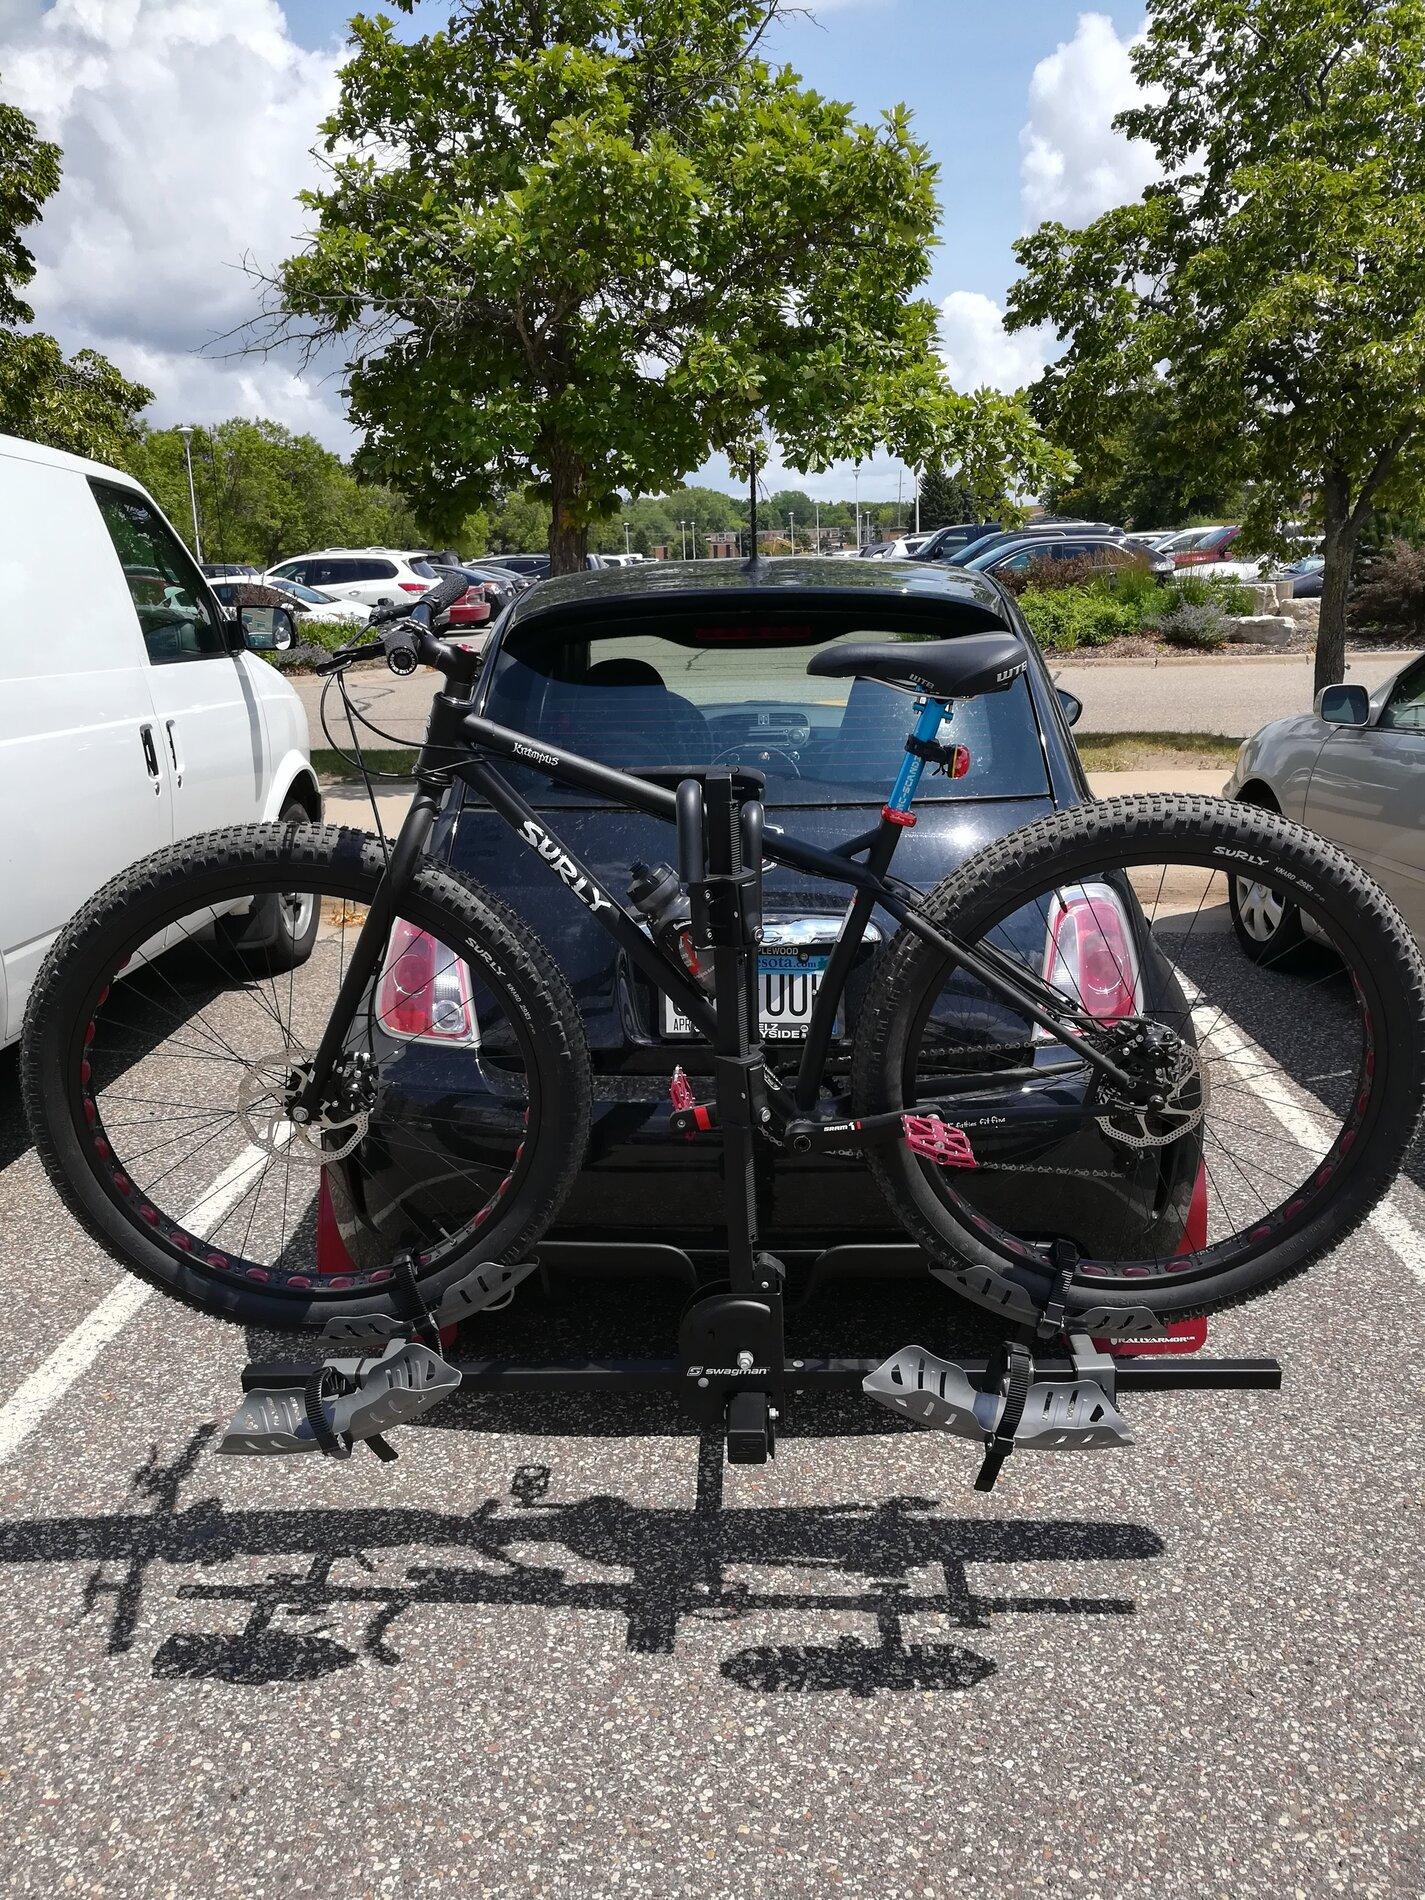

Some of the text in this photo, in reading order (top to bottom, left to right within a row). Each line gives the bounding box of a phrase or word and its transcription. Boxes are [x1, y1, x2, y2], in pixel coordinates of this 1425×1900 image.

[909, 673, 935, 689] WTB
[997, 660, 1027, 682] WTB
[516, 820, 613, 912] SURLY
[1212, 846, 1270, 866] SURLY
[1274, 866, 1296, 881] KNARD
[464, 937, 507, 976] SURLY
[705, 1367, 767, 1376] swagman
